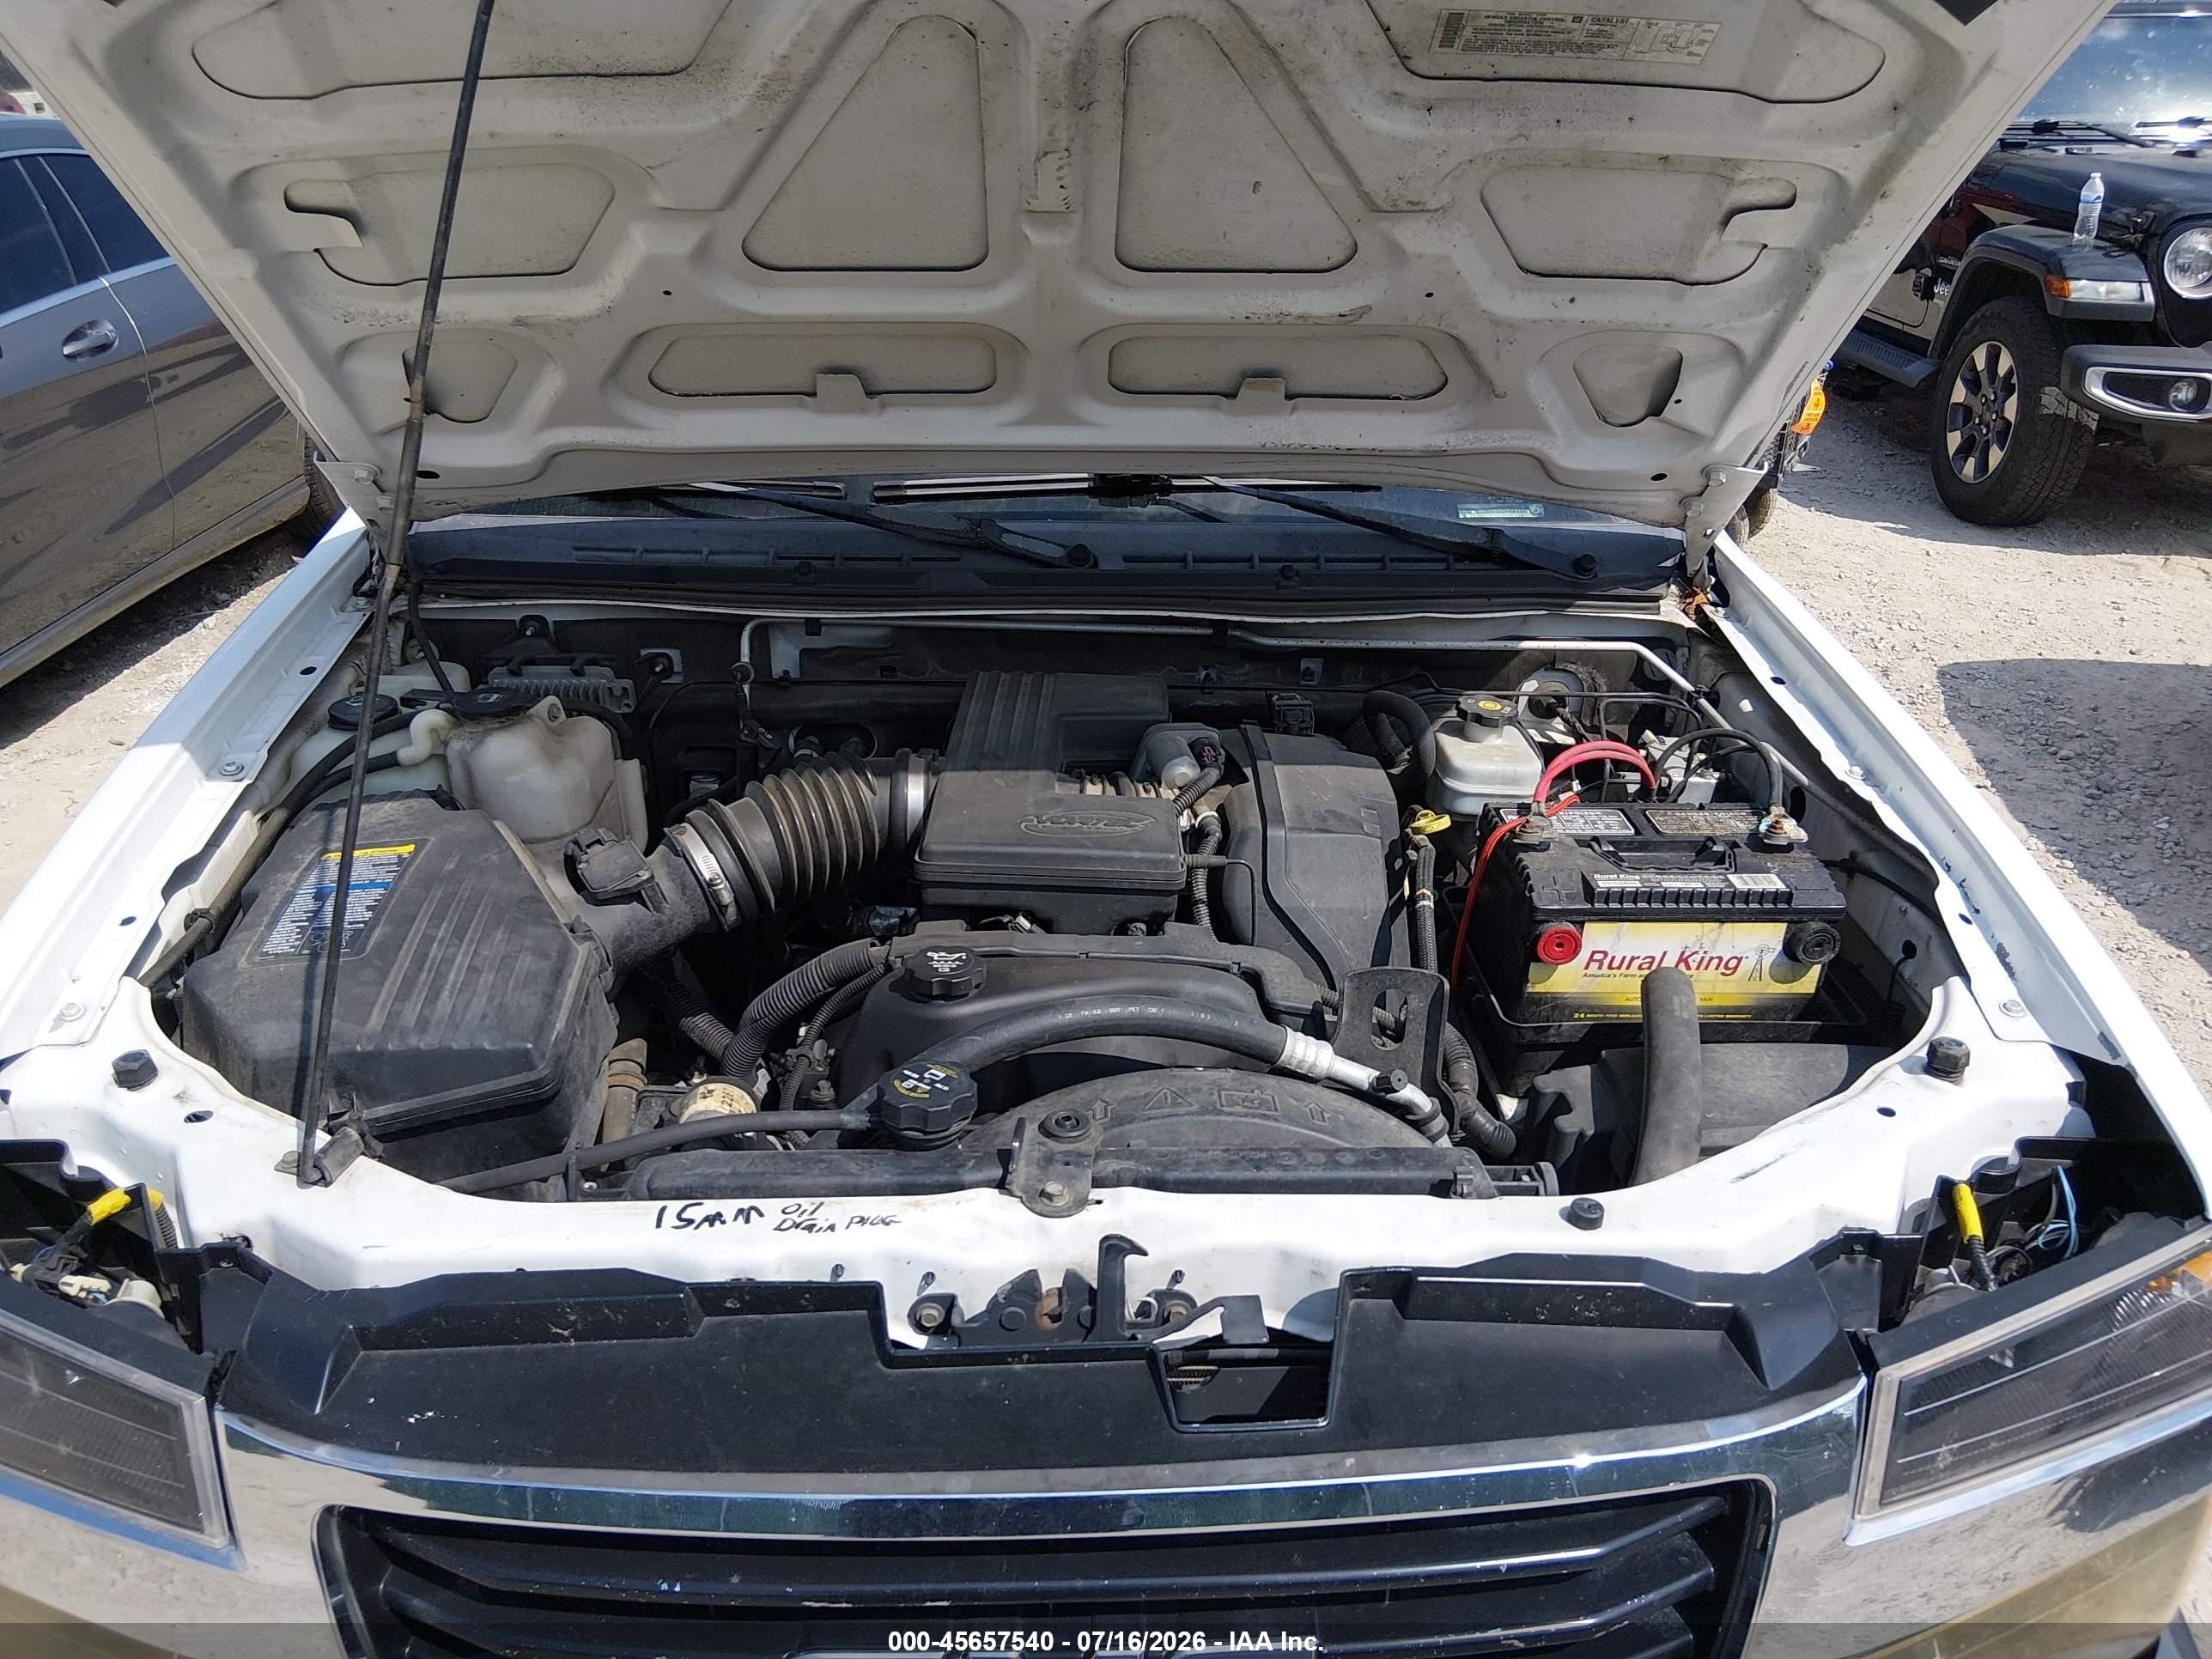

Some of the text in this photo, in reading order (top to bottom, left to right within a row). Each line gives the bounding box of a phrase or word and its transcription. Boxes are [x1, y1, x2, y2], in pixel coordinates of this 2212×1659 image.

[1934, 277, 1950, 296] Jee
[1583, 949, 1744, 977] Rural King
